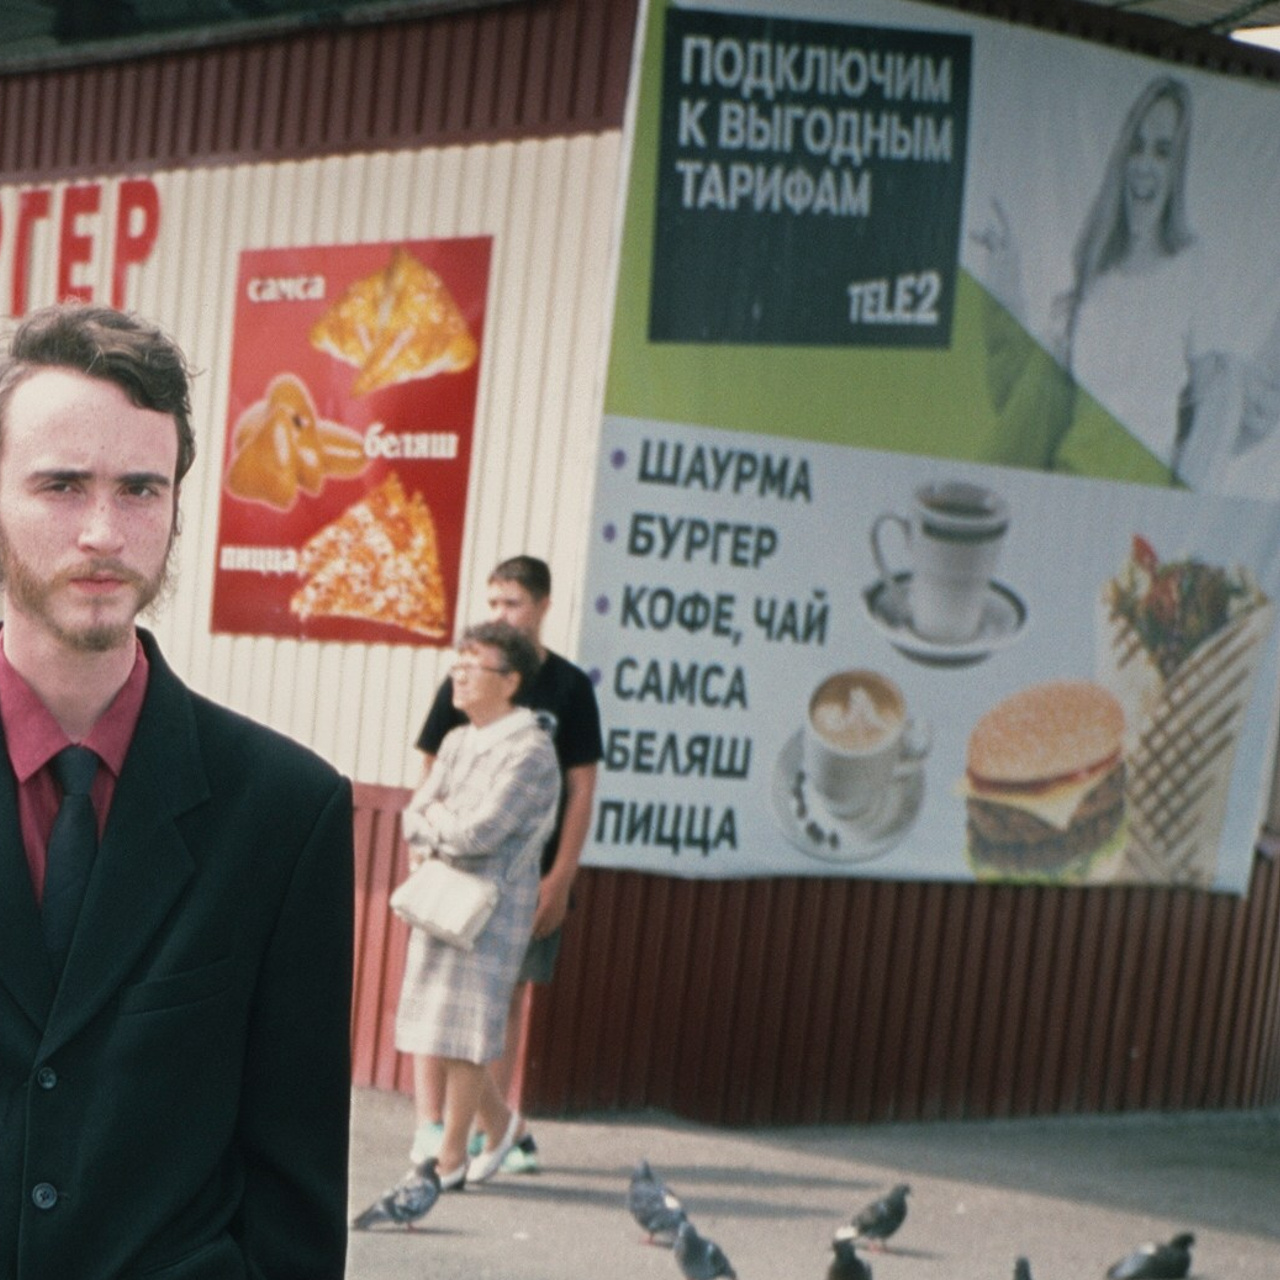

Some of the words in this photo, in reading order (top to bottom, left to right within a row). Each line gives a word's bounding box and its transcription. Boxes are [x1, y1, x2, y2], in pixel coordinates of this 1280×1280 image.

[681, 36, 952, 103] ПОДКЛЮЧИМ
[677, 99, 706, 147] К
[718, 103, 953, 166] ВЫГОДНЫМ
[676, 160, 870, 217] ТАРИФАМ
[848, 272, 942, 325] TELE2
[637, 439, 812, 502] ШАУРМА
[627, 512, 778, 569] БУРГЕР
[620, 585, 744, 647] КОФЕ,
[753, 590, 830, 646] ЧАЙ
[613, 658, 748, 709] САМСА
[604, 729, 752, 780] БЕЛЯШ
[595, 800, 738, 858] ПИЦЦА
